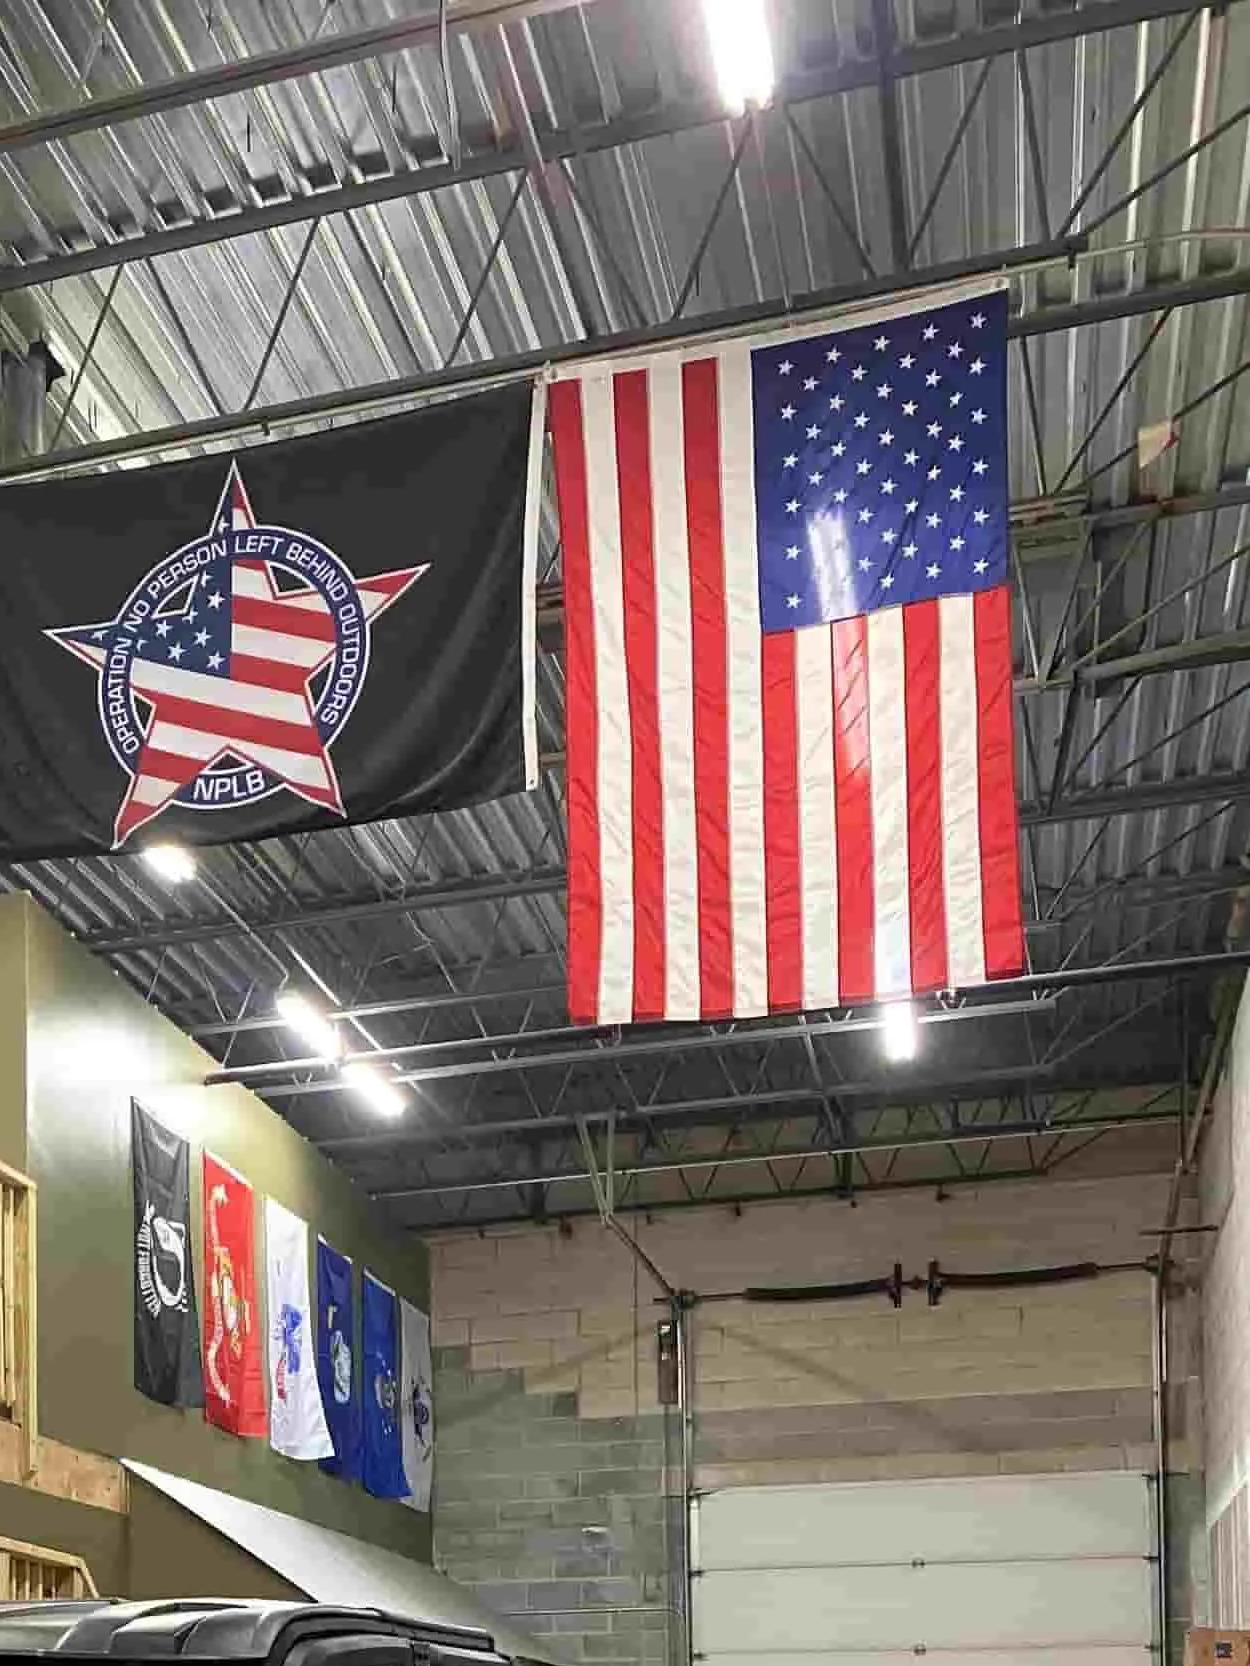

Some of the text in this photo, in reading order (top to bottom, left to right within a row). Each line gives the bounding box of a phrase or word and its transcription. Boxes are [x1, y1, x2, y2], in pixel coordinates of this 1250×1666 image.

[107, 536, 360, 754] OPERATION NO PERSON LEFT BEHIND OUTDOORS
[193, 769, 265, 801] NPLB
